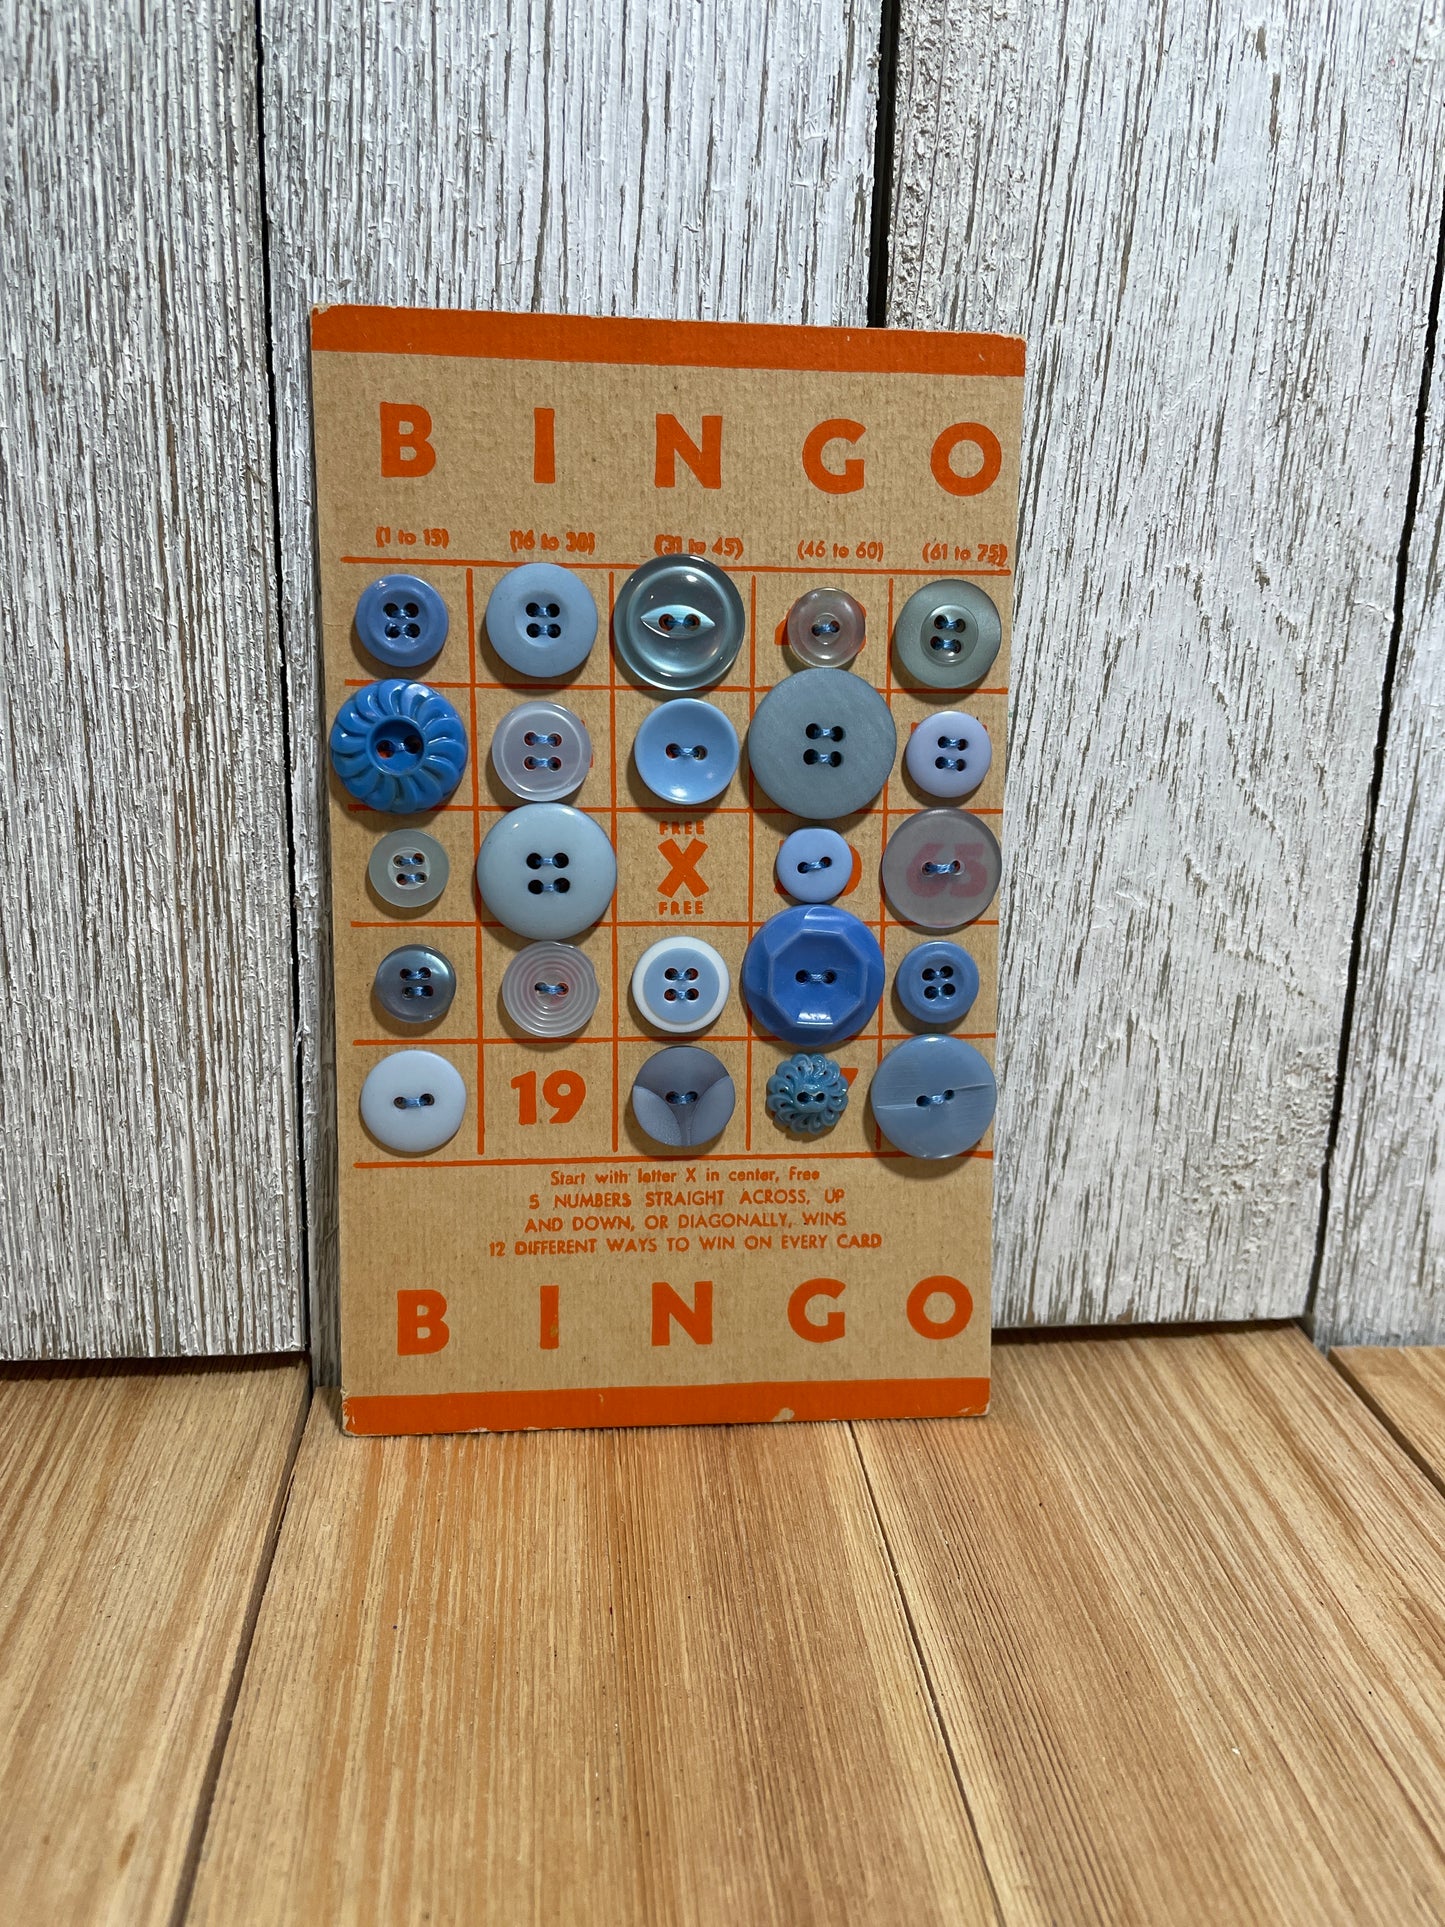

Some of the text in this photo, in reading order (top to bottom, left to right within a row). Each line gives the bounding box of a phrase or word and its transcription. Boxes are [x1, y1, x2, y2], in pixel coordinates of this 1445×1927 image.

[398, 529, 417, 546] to
[423, 527, 450, 549] 15)
[509, 529, 596, 555] (16 to 30)
[688, 538, 707, 555] to
[712, 536, 744, 560] 45)
[797, 539, 884, 562] (46 to 60)
[922, 542, 1008, 567] (61 to 75)
[659, 820, 705, 836] FREE
[657, 838, 710, 898] X
[906, 842, 988, 898] 65
[658, 901, 704, 915] FREE
[511, 1070, 587, 1125] 19
[550, 1166, 820, 1186] Start with letter X in center, Free
[529, 1188, 845, 1210] 5 NUMBERS STRAIGHT ACROSS, UP
[524, 1211, 848, 1233] AND DOWN, OR DIAGONALLY, WINS
[490, 1233, 883, 1257] 12 DIFFERENT WAYS TO WIN ON EVERY CARD
